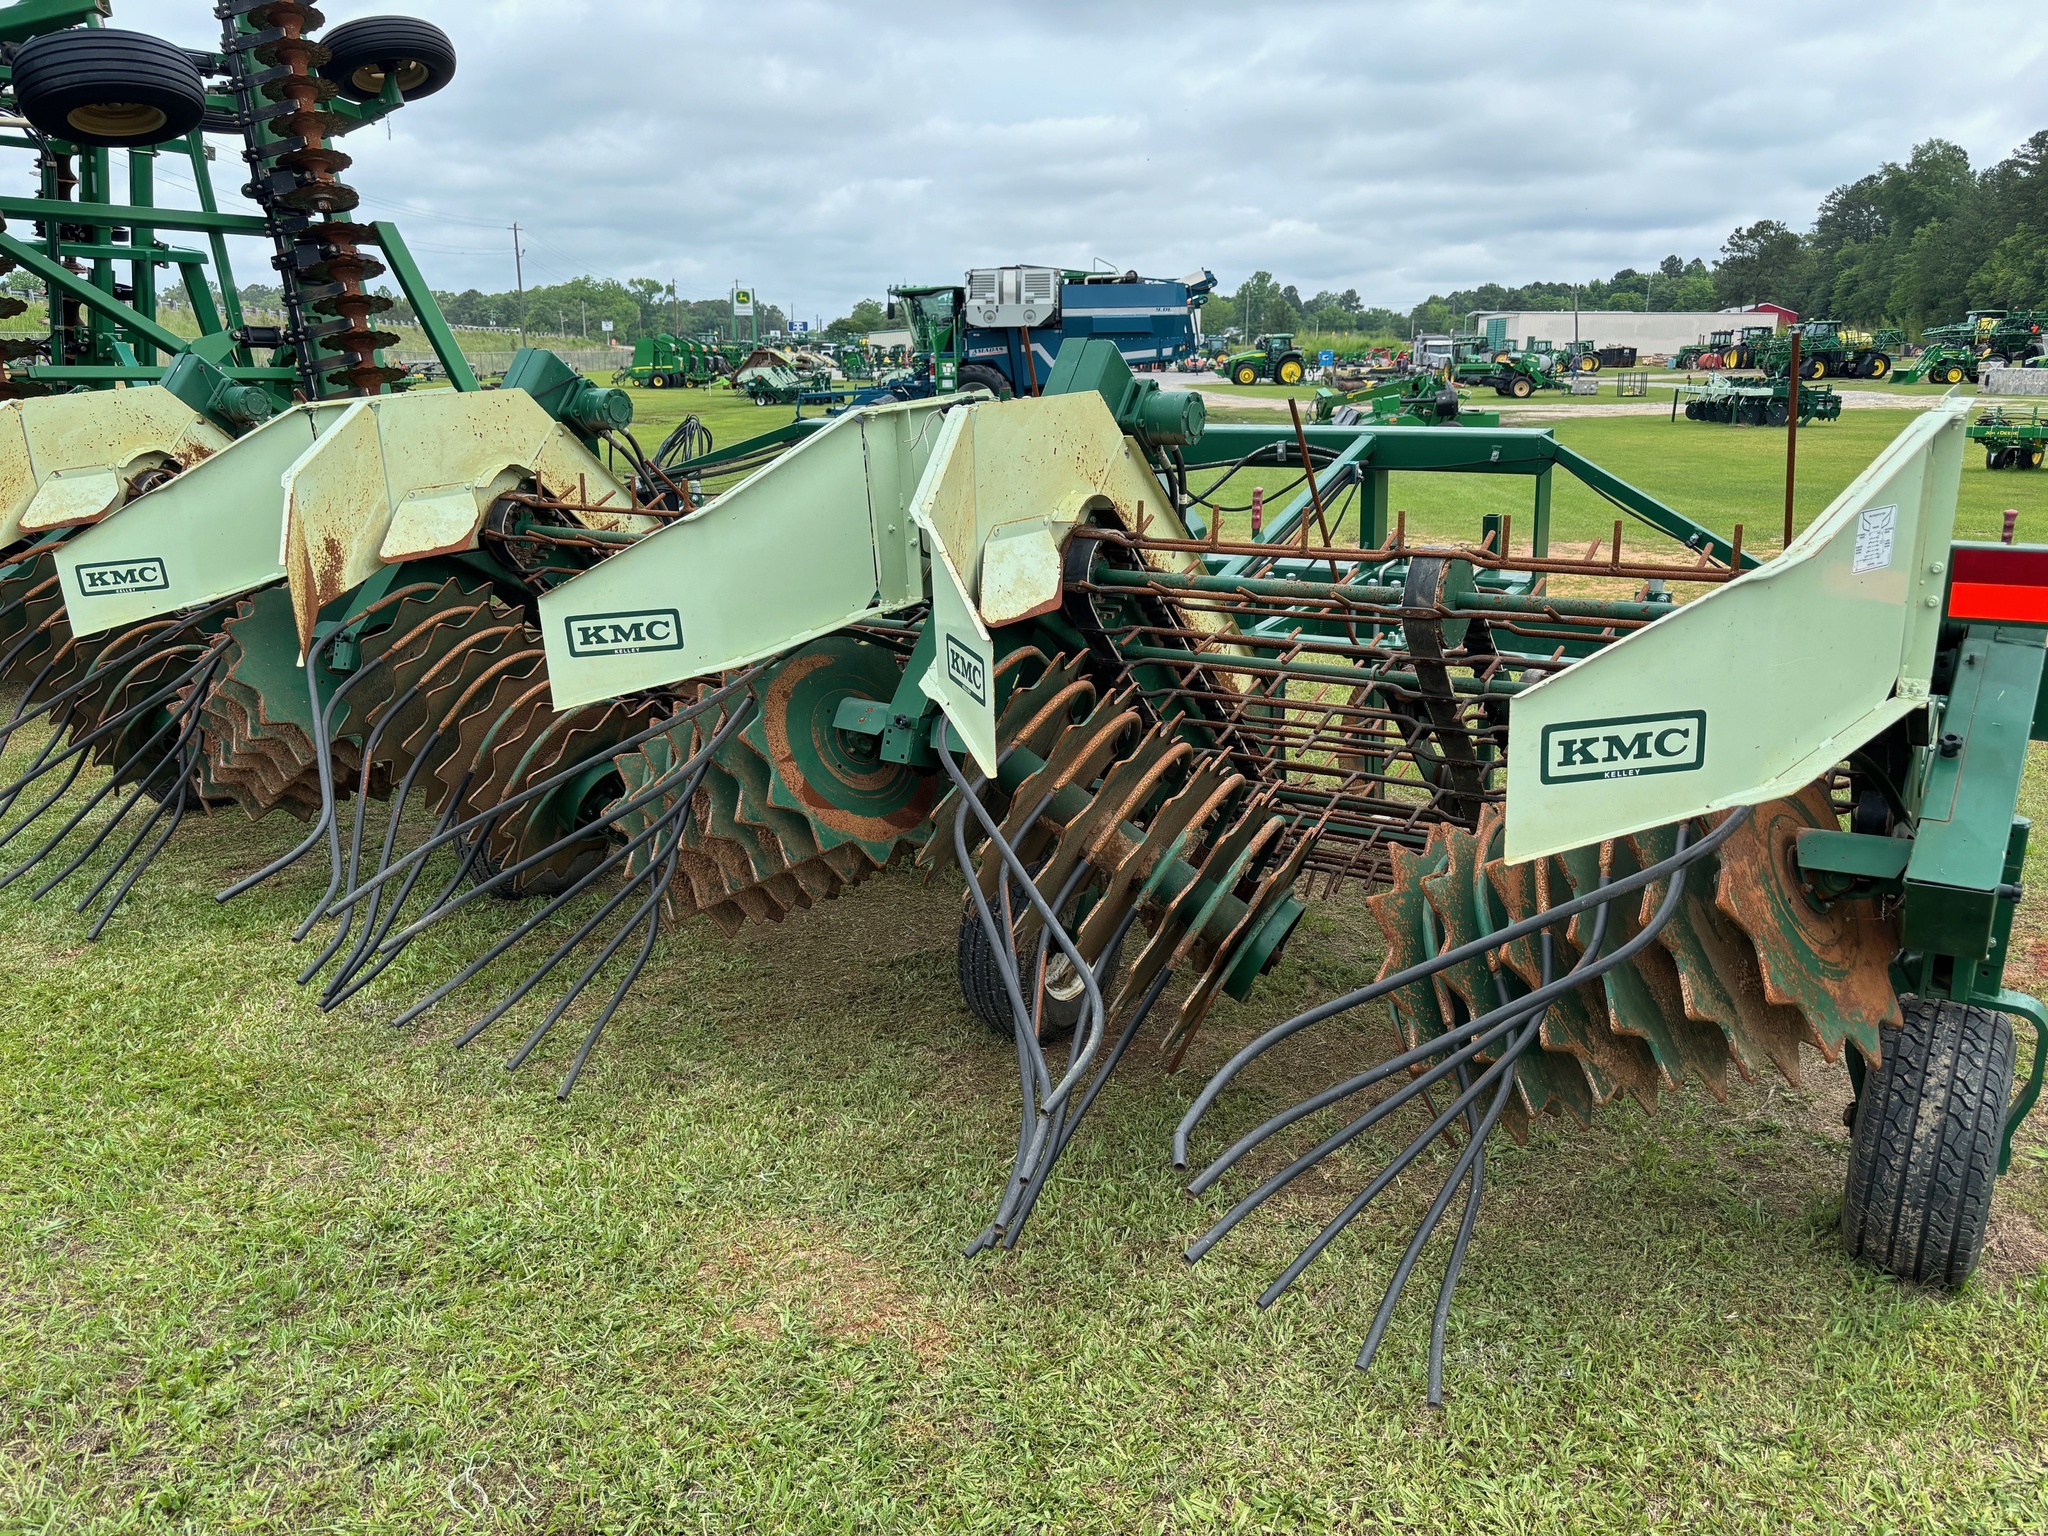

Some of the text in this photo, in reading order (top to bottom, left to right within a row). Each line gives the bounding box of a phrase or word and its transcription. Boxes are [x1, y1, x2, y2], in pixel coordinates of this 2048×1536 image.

[971, 347, 1004, 356] AMADAS
[85, 566, 158, 588] KMC
[577, 620, 671, 646] KMC
[614, 647, 640, 655] KELLEY
[949, 647, 982, 690] KMC
[1557, 727, 1690, 768] KMC
[1604, 768, 1641, 779] KELLEY
